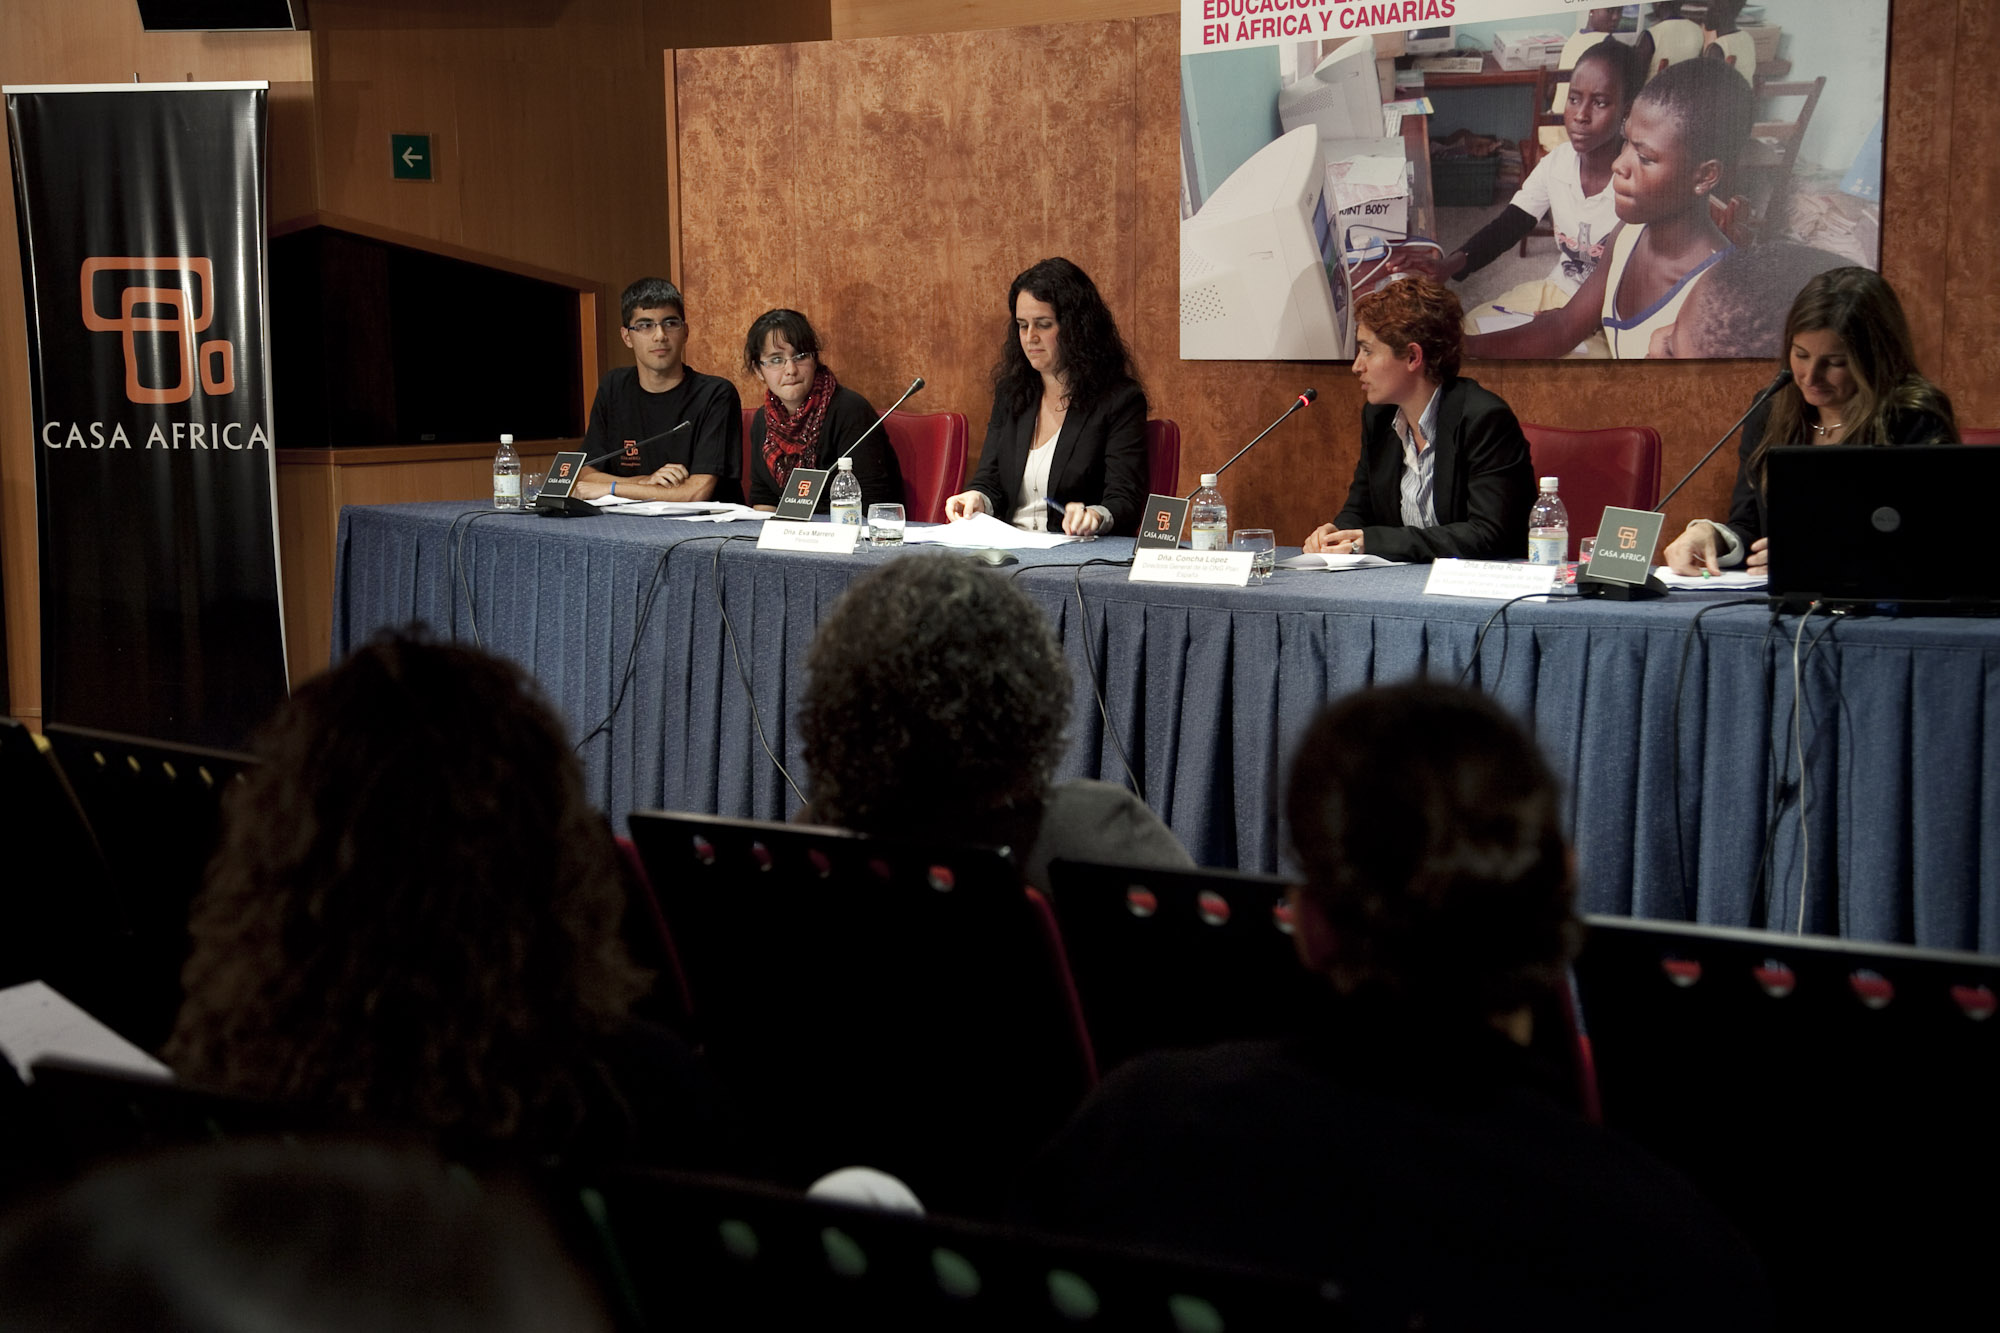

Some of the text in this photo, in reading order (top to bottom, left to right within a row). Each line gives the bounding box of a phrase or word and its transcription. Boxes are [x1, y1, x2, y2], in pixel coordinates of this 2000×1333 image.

[1203, 0, 1325, 20] EDUCAC
[1203, 0, 1455, 45] EN ÁFRICA Y CANARIAS
[1365, 204, 1390, 215] BODY
[42, 421, 270, 450] CASA AFRICA
[811, 530, 835, 538] Marrero
[1143, 530, 1176, 542] CASA AFRICA
[1176, 554, 1203, 562] Concha
[1599, 549, 1646, 563] CASA AFRICA
